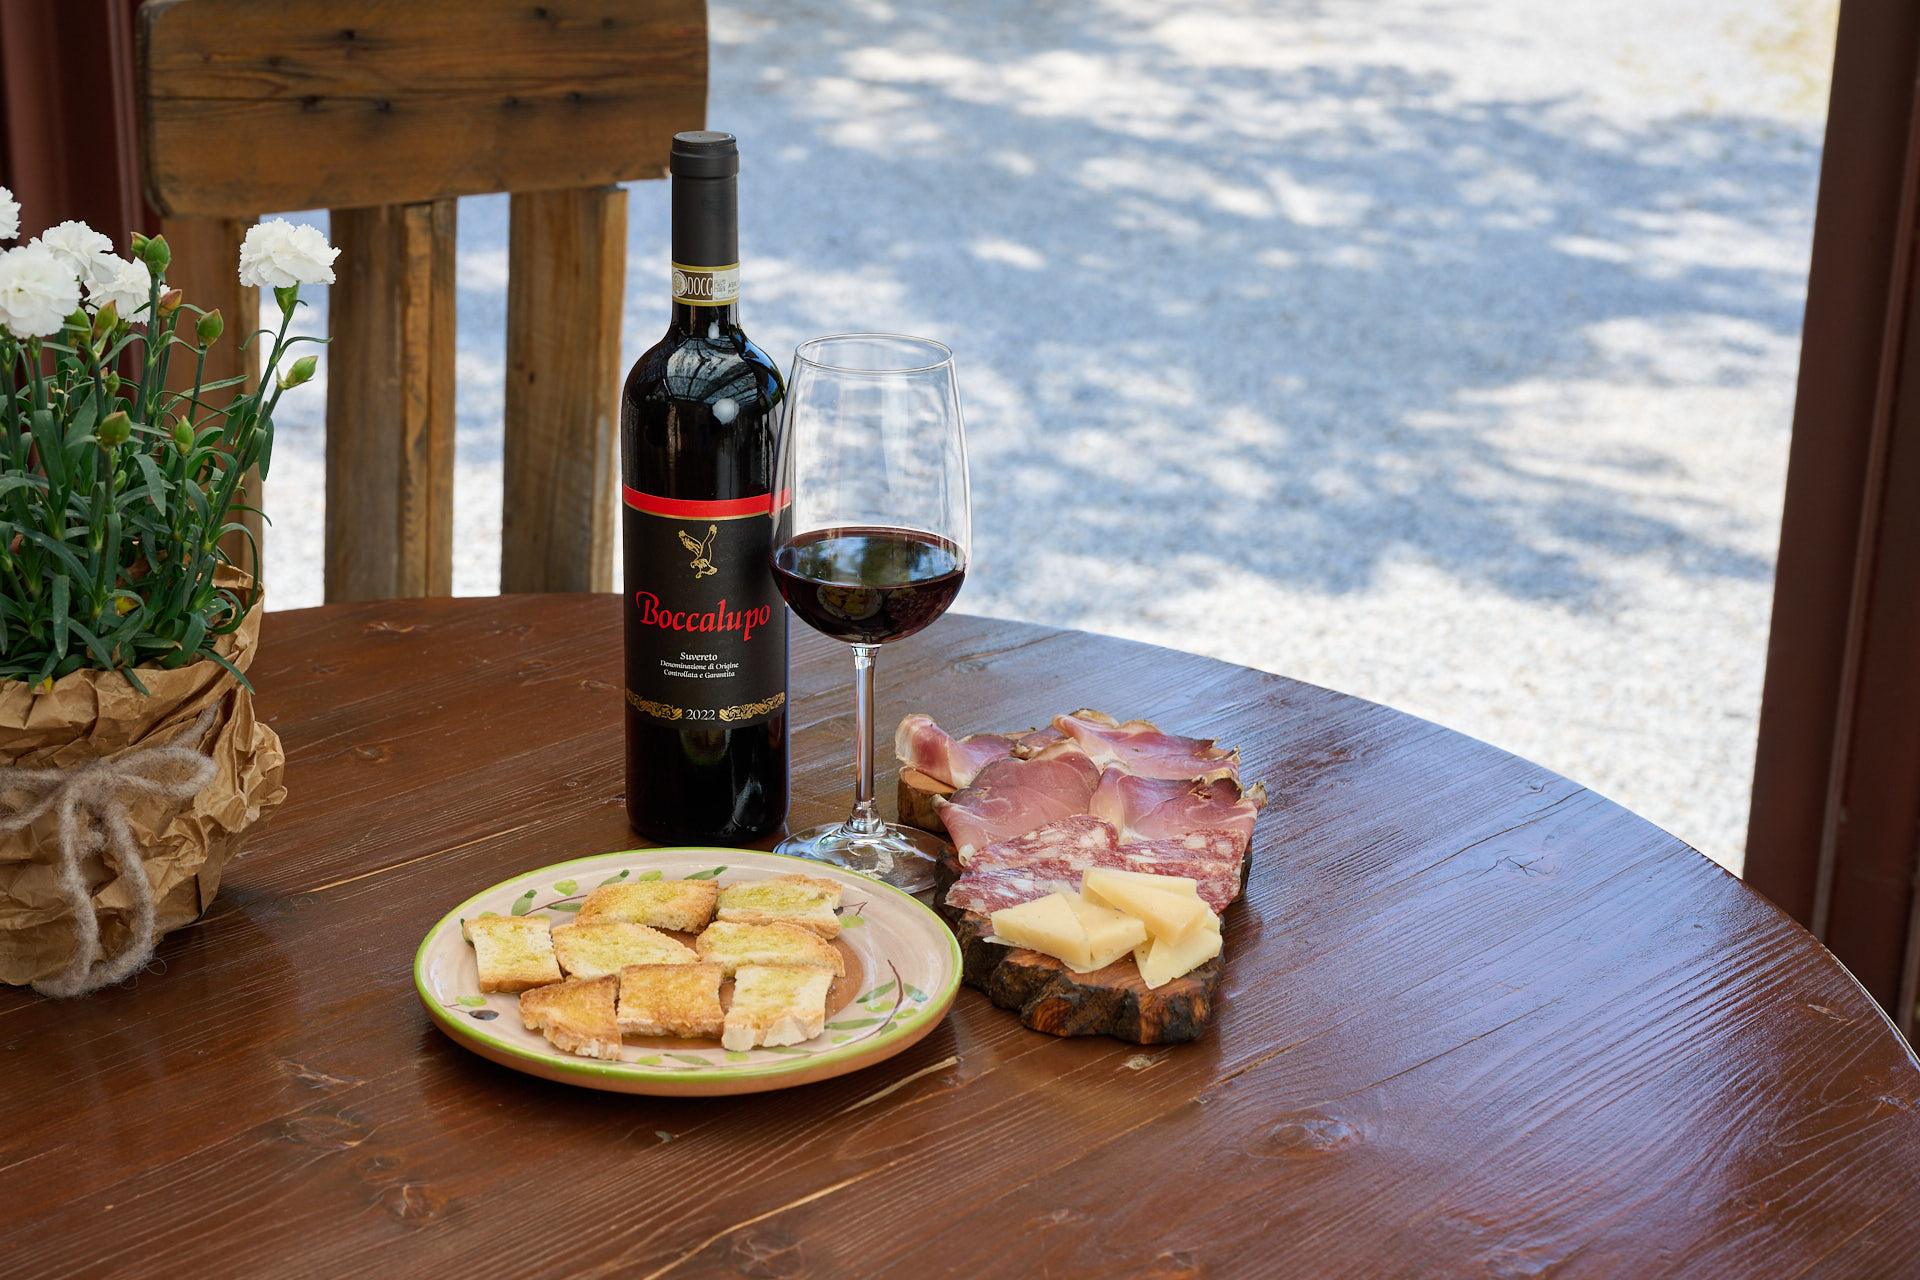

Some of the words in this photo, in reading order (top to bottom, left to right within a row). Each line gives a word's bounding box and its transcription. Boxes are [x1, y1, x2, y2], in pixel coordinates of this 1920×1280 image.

[687, 277, 713, 296] DOCG
[635, 590, 771, 642] Boccalupo
[680, 651, 718, 661] Suvereto
[660, 660, 707, 670] Denominazione
[715, 662, 739, 671] Origine
[663, 669, 698, 678] Controllata
[704, 669, 735, 678] Garantita
[685, 708, 716, 720] 2022
